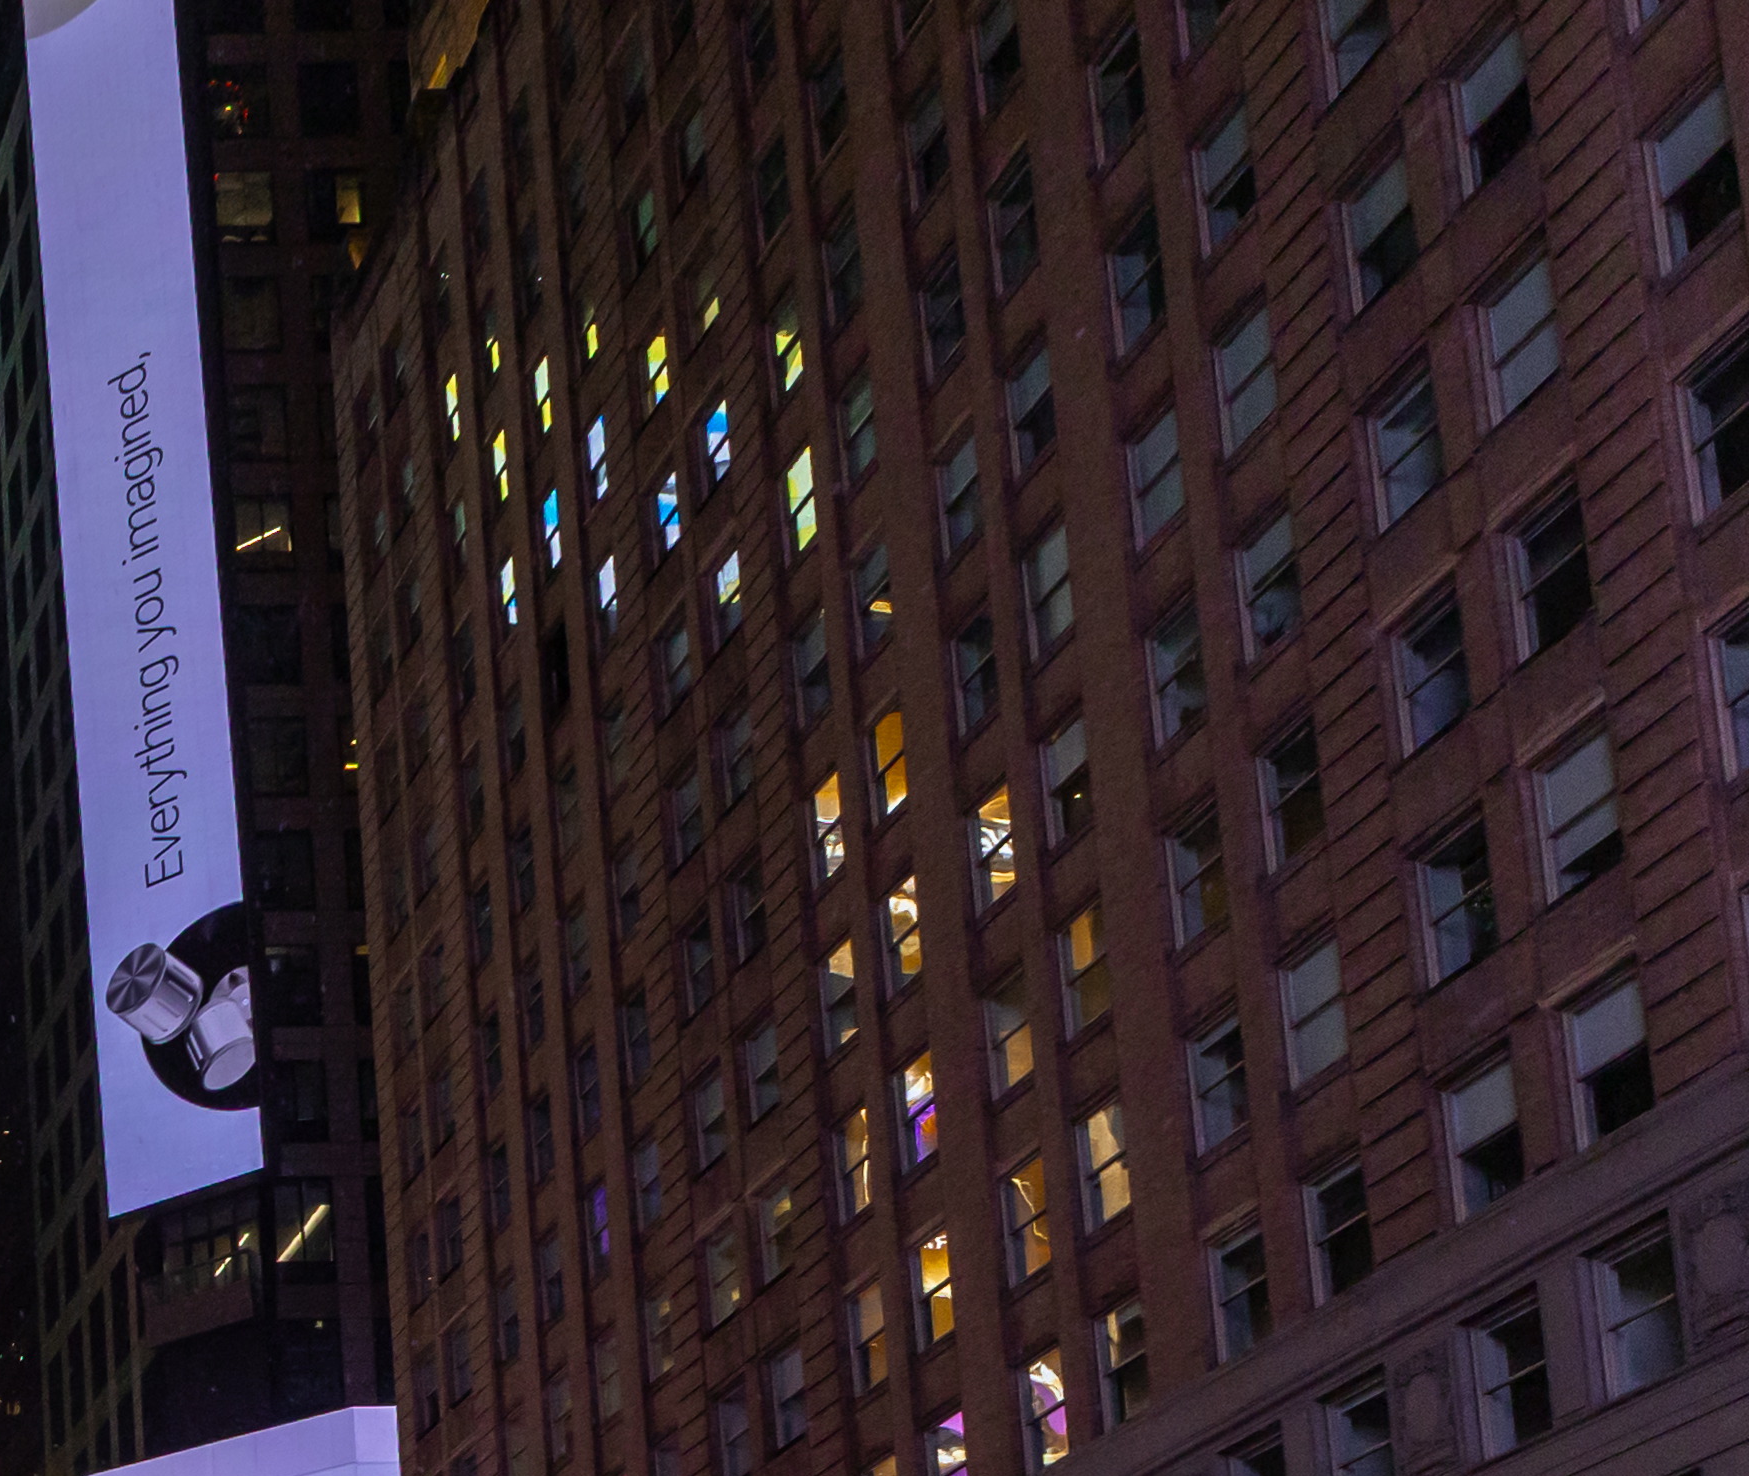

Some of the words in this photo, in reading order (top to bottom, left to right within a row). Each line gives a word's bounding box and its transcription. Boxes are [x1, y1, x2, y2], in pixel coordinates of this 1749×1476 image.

[107, 350, 163, 567] imagined,
[132, 565, 178, 640] you
[135, 652, 185, 890] Everything
